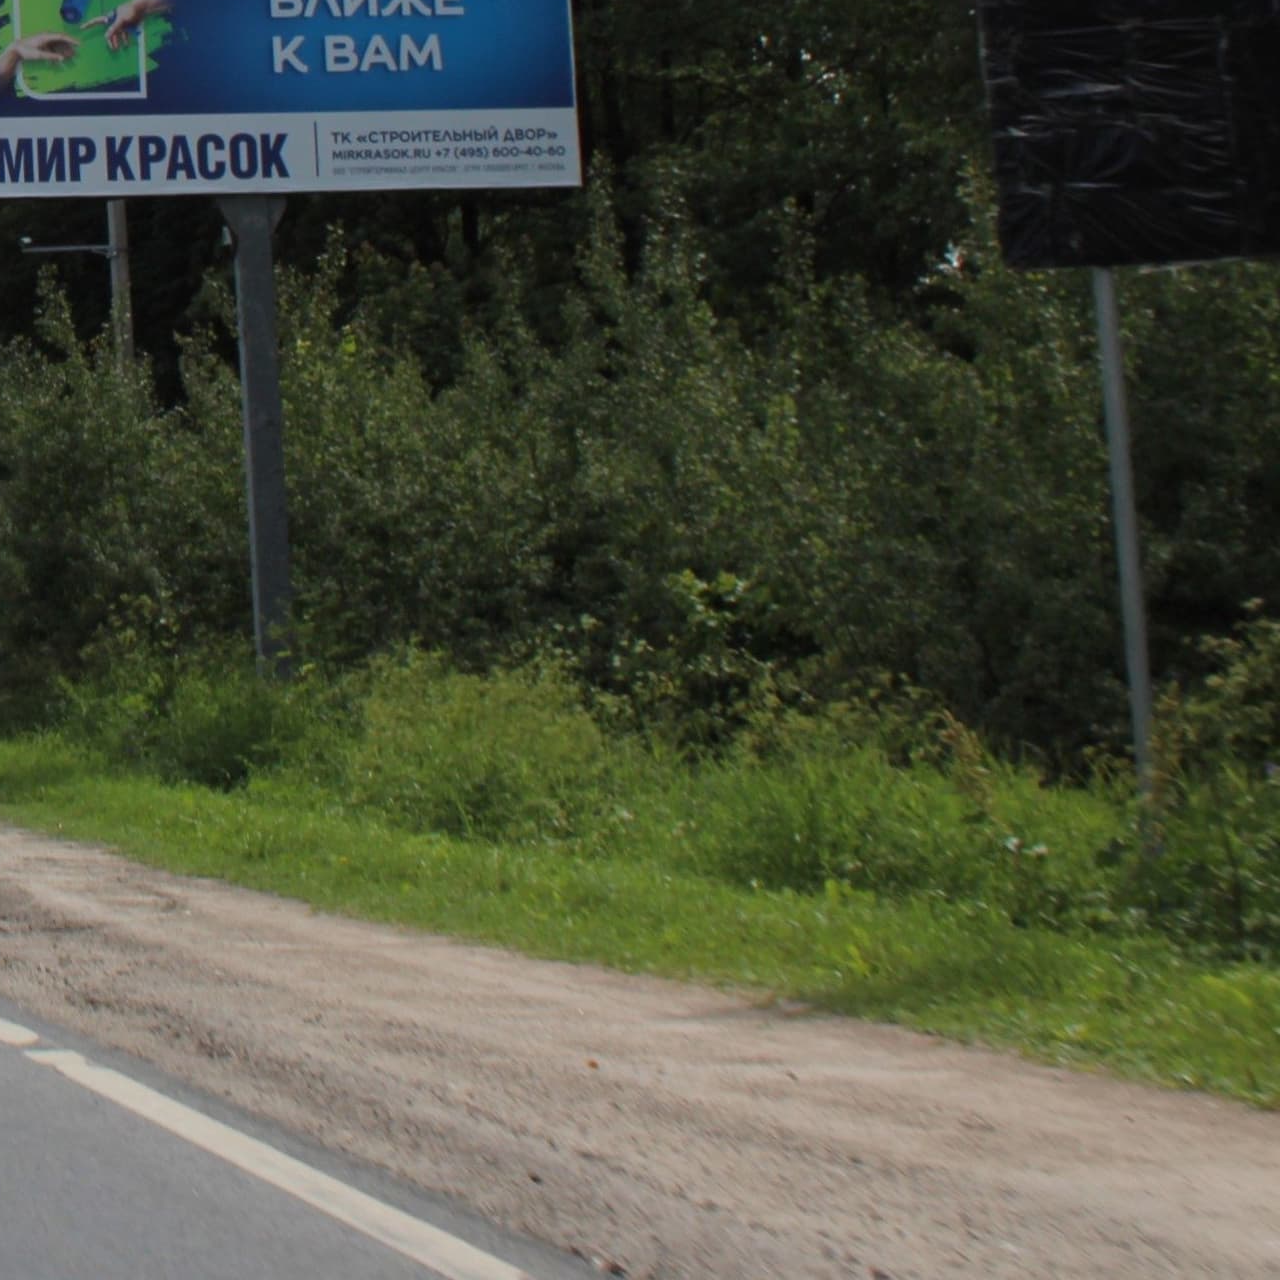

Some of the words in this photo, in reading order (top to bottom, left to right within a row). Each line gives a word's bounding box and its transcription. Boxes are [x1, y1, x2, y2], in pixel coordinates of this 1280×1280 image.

[272, 35, 309, 73] К
[323, 33, 443, 72] ВАМ
[331, 131, 351, 144] ТК
[356, 125, 499, 144] «СТРОИТЕЛЬНЫЙ
[503, 127, 558, 143] ДВОР»
[105, 132, 290, 181] КРАСОК
[332, 148, 431, 161] MIRKRASOK.RU
[454, 146, 489, 160] (495)
